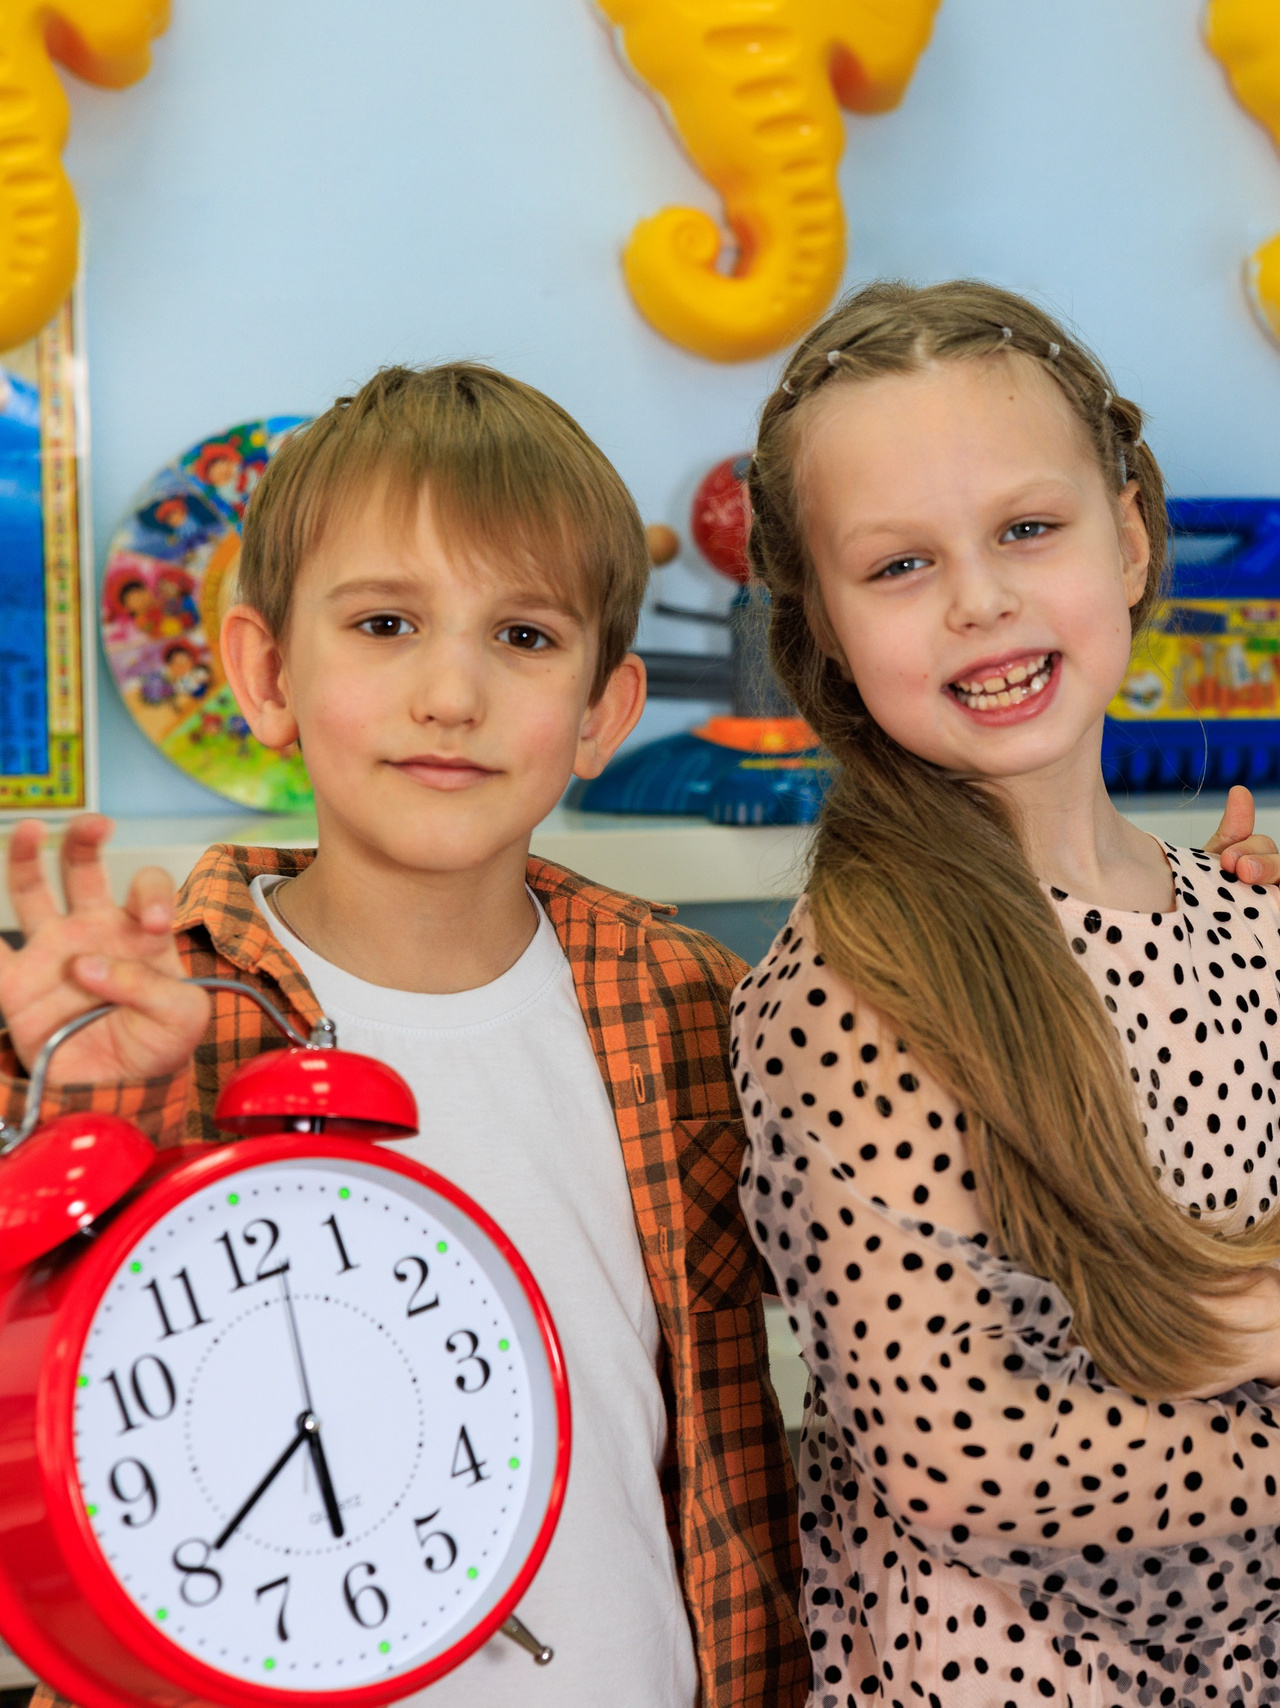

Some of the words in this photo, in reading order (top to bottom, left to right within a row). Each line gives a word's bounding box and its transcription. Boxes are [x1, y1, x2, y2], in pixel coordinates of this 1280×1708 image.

[214, 1217, 291, 1294] 12
[320, 1213, 361, 1276] 1
[141, 1266, 213, 1342] 11
[393, 1255, 441, 1319] 2
[102, 1352, 177, 1437] 10
[445, 1329, 492, 1394] 3
[450, 1424, 492, 1489] 4
[108, 1457, 160, 1528] 9
[172, 1537, 224, 1608] 8
[413, 1507, 459, 1575] 5
[255, 1576, 291, 1643] 7
[342, 1562, 391, 1629] 6
